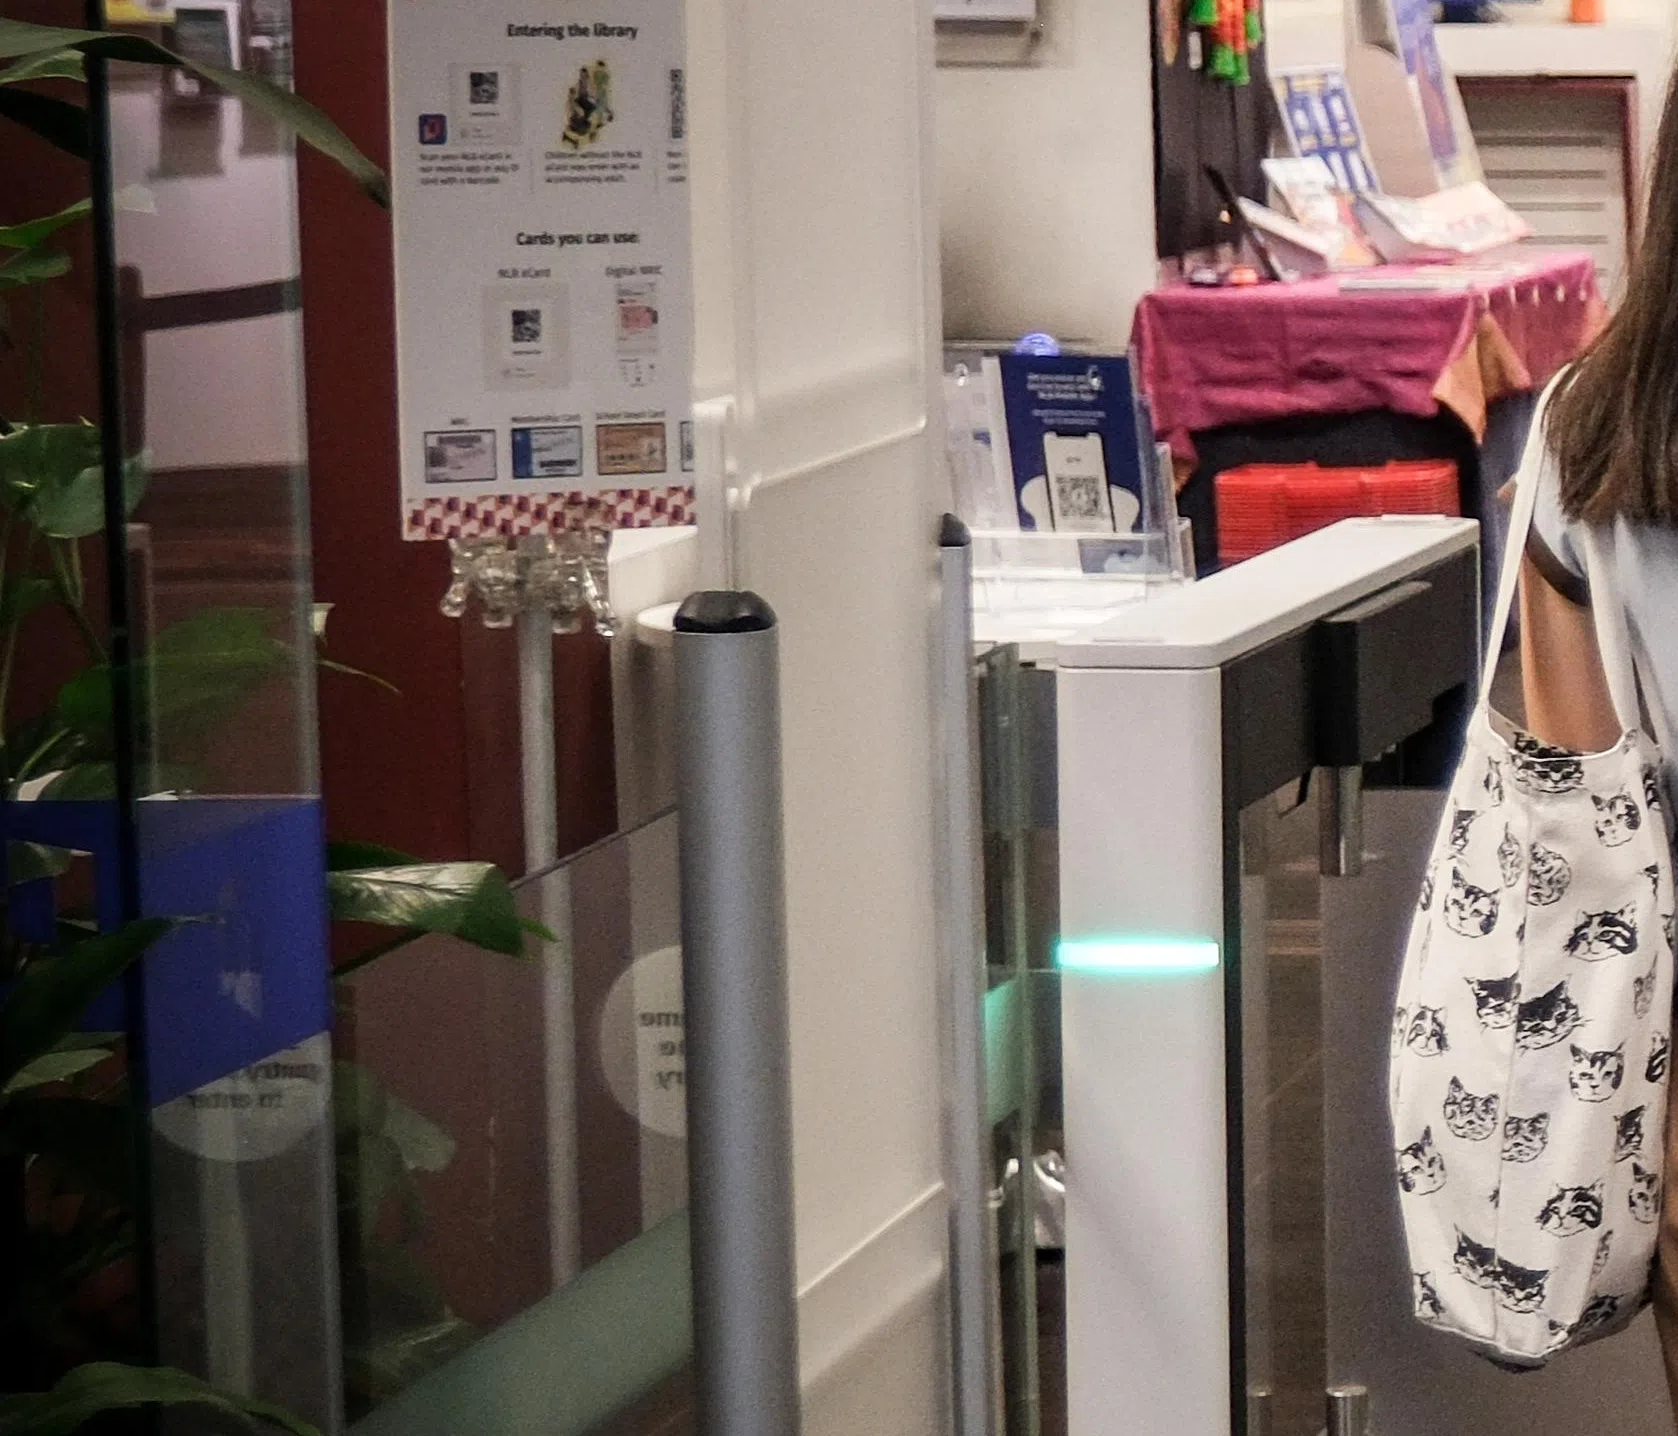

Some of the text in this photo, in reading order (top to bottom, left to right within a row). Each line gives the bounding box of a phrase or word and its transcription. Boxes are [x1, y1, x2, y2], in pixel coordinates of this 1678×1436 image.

[507, 22, 638, 41] Entering the library
